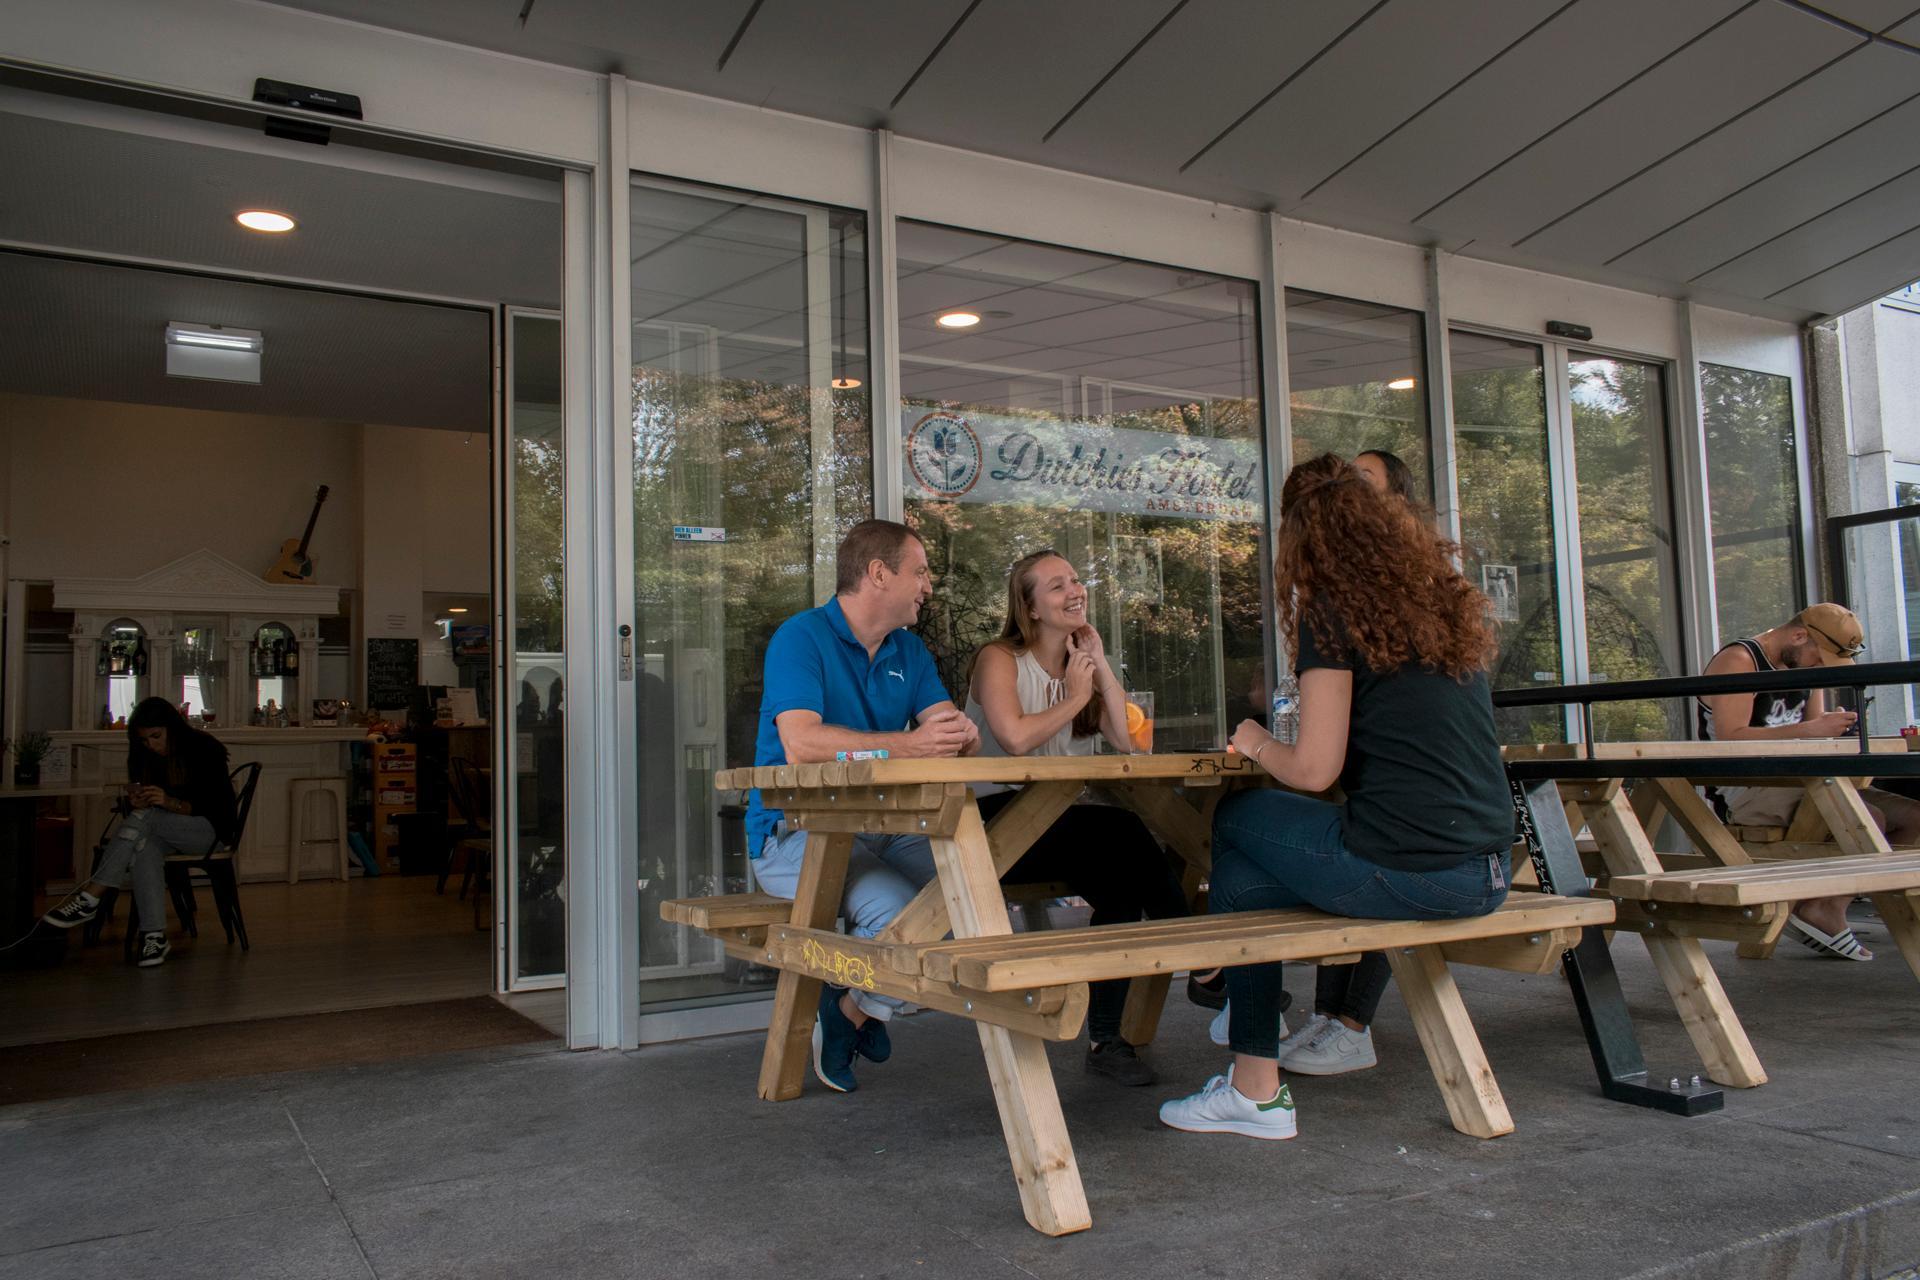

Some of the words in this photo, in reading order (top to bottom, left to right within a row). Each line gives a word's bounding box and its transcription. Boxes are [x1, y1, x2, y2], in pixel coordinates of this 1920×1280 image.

[990, 431, 1142, 491] Dutchies
[1147, 446, 1257, 501] Hostel
[1146, 497, 1253, 518] AMSTERDAM
